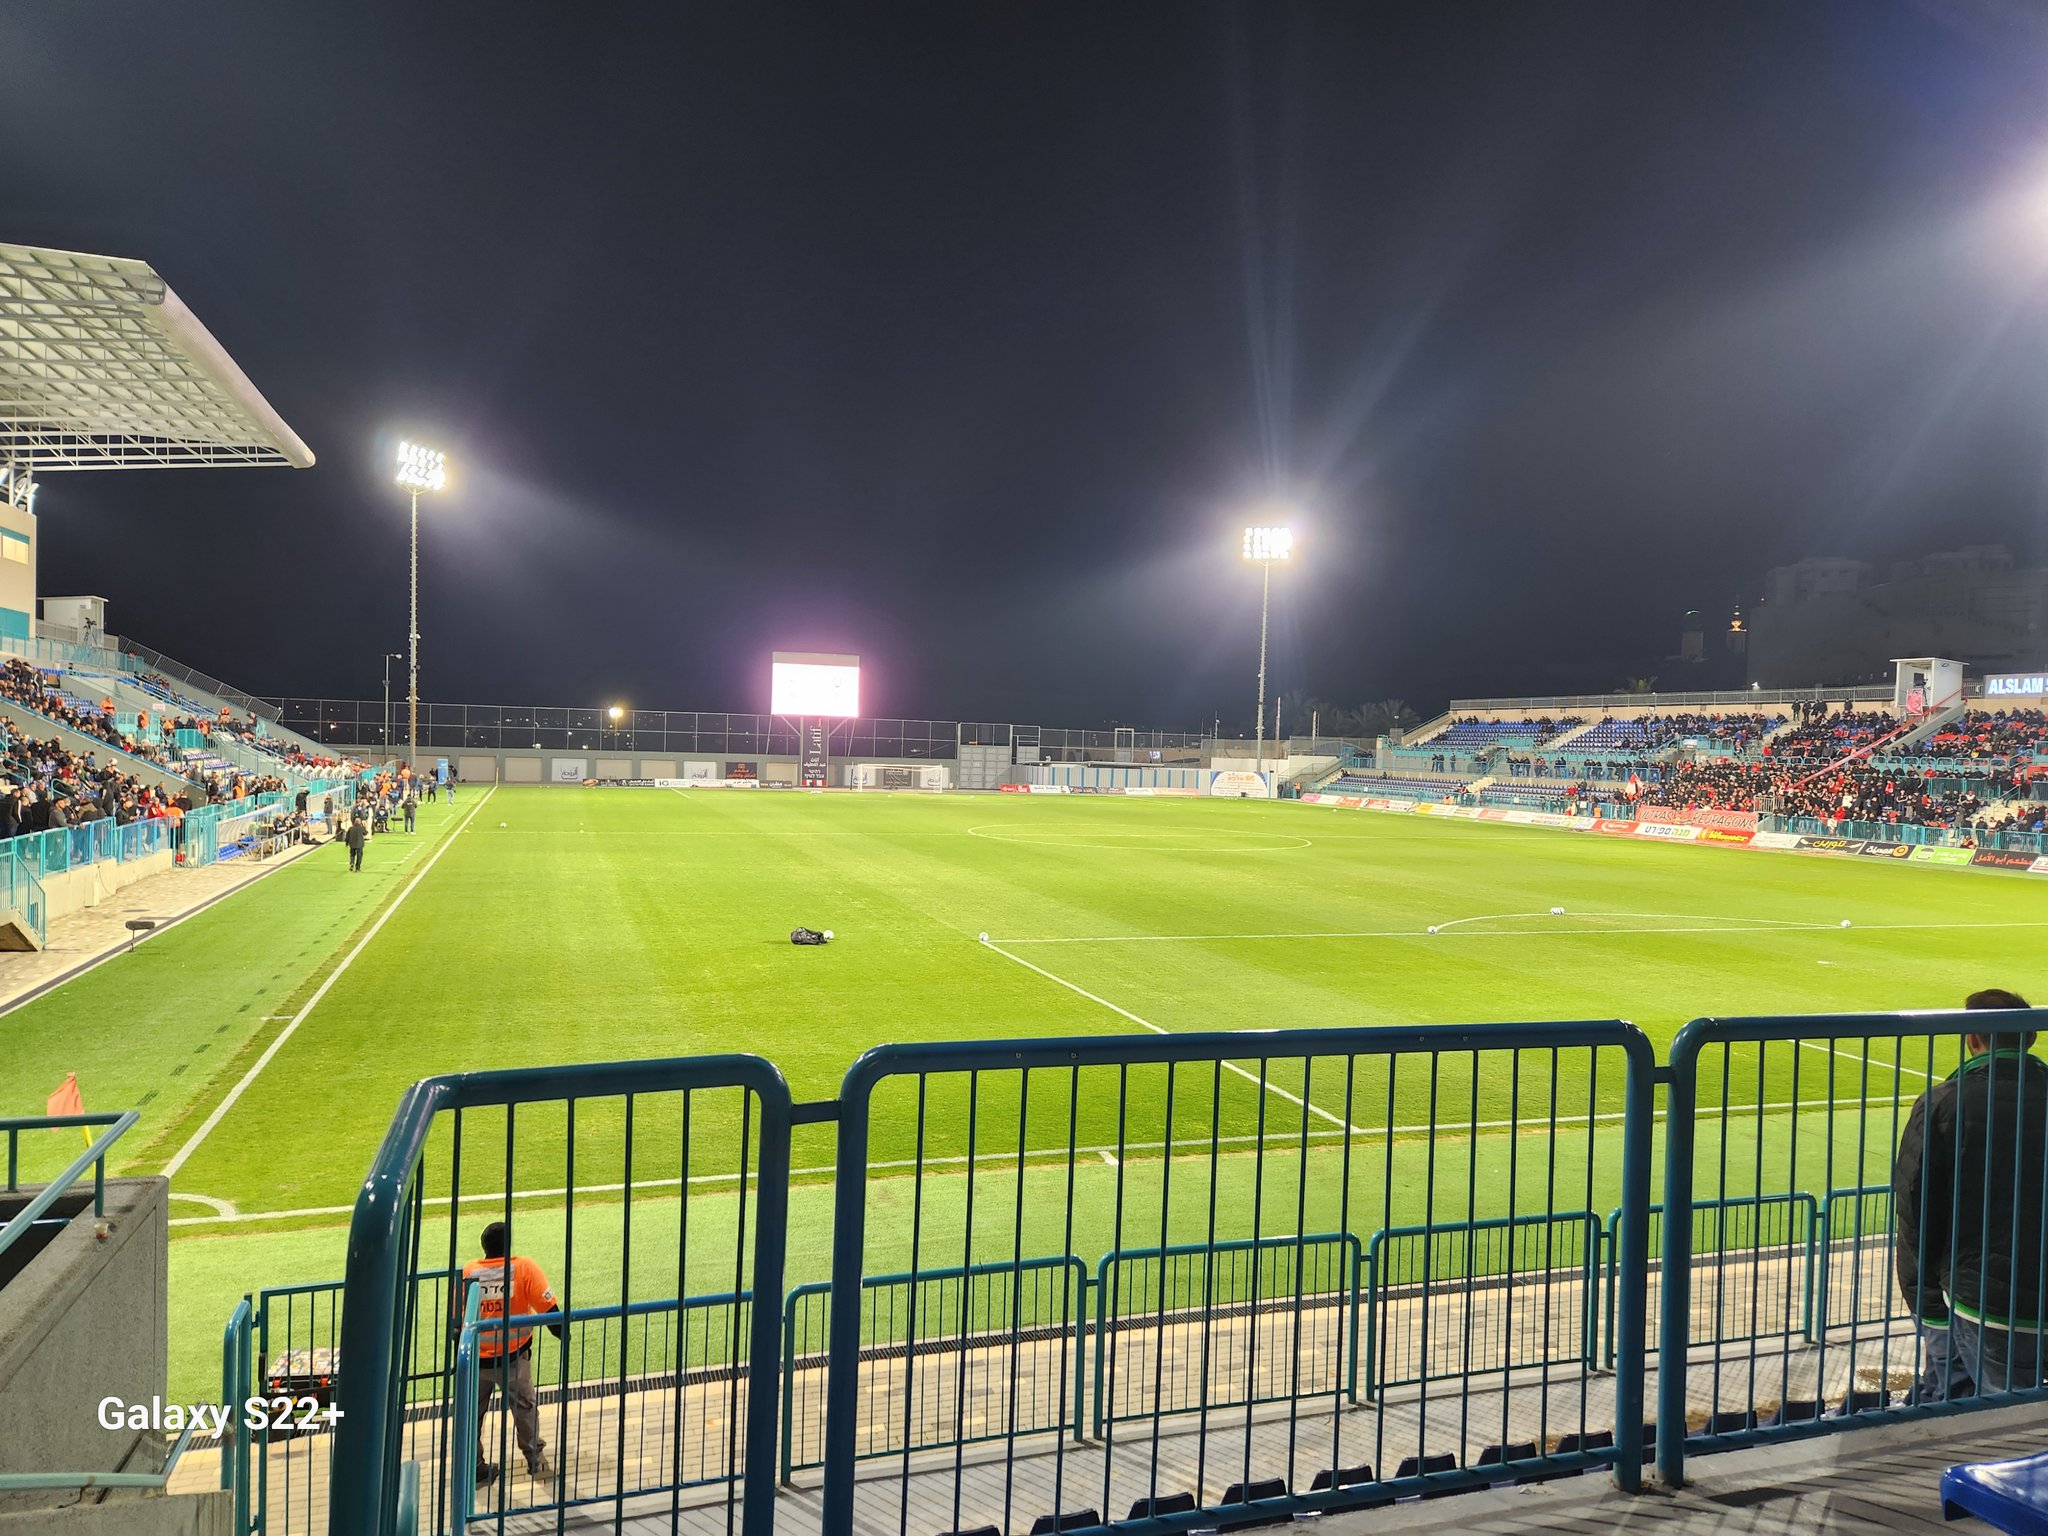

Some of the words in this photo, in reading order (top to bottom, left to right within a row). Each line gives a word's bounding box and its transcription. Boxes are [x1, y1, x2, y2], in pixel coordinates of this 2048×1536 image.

[1987, 678, 2044, 694] ALSLAM
[1638, 808, 1675, 821] ULTRAS
[1692, 812, 1757, 831] REDRAGONS
[1708, 830, 1748, 842] Winner
